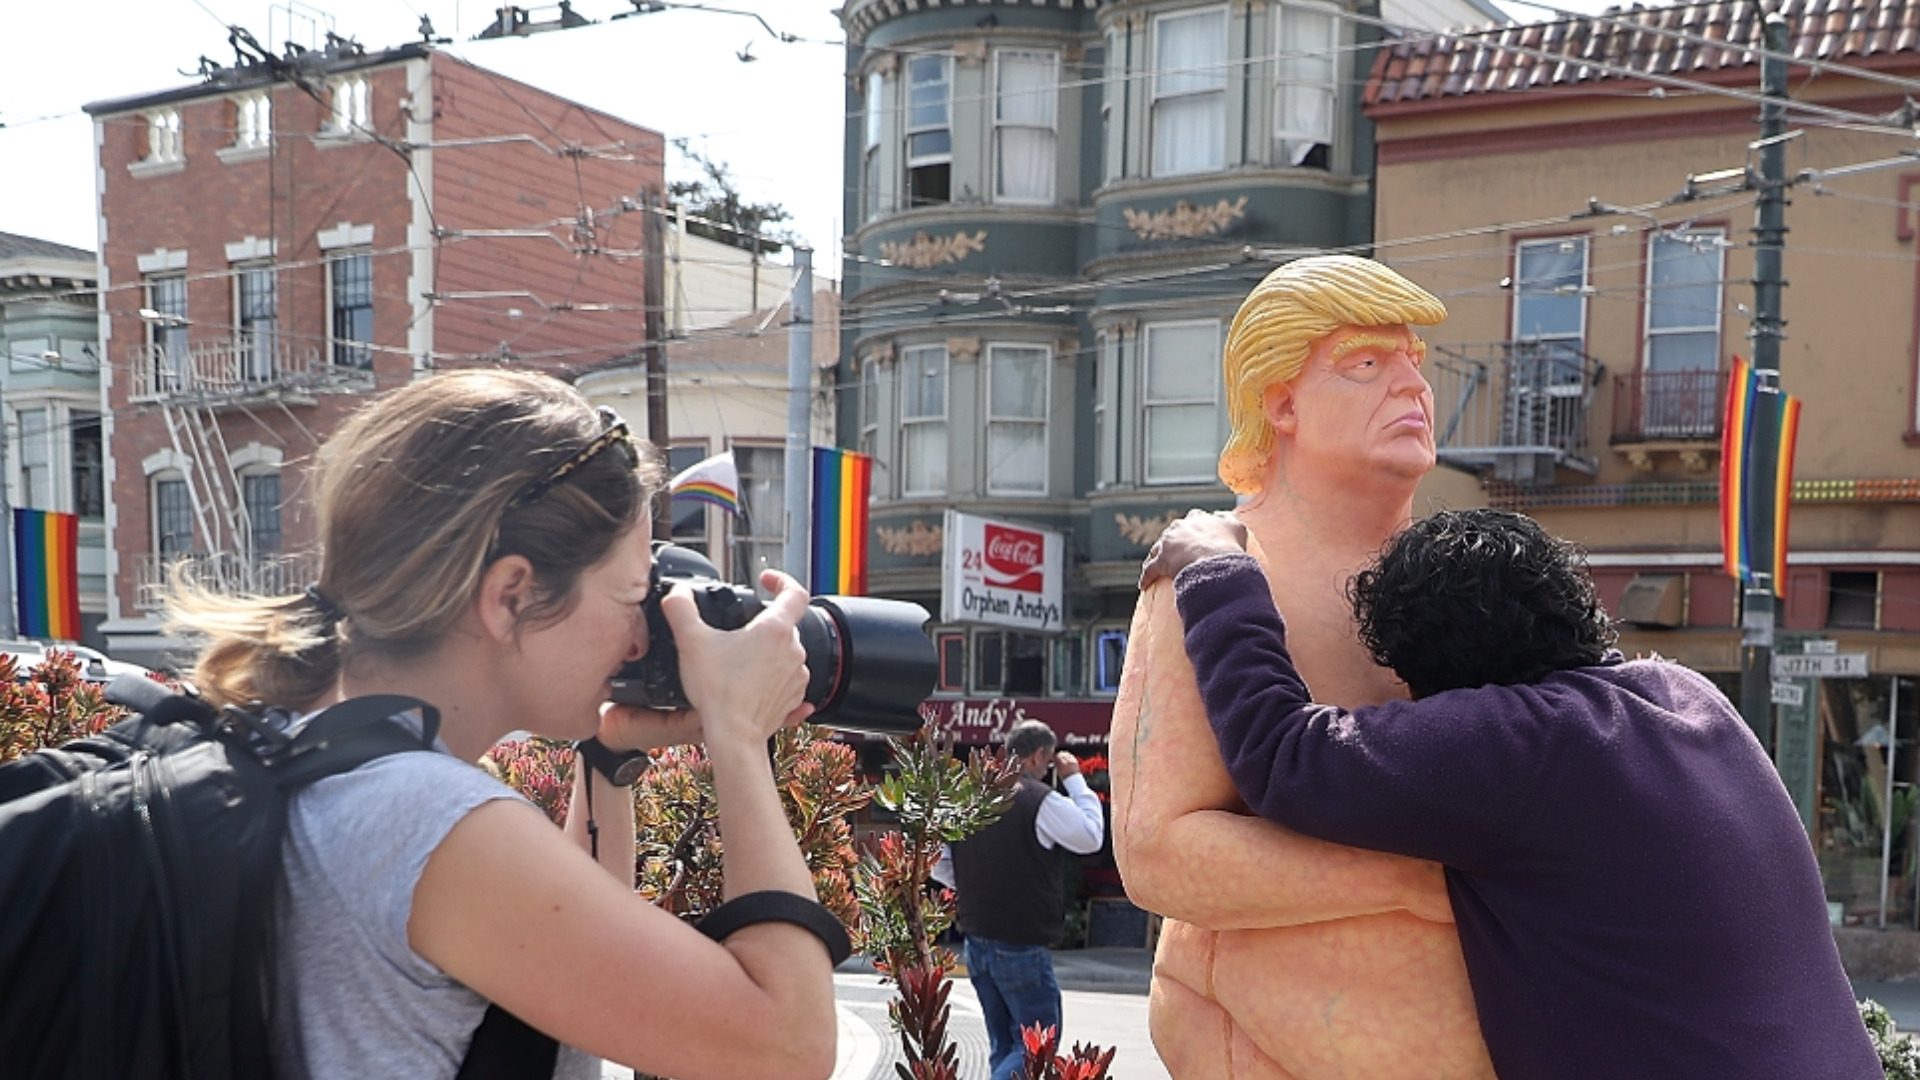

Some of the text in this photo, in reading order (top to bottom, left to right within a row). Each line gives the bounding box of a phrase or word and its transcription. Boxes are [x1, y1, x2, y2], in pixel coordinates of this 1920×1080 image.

[962, 548, 982, 571] 24
[962, 586, 1060, 629] Orphan Andy's
[1789, 657, 1850, 673] 17TH ST
[943, 698, 1026, 731] Andy's
